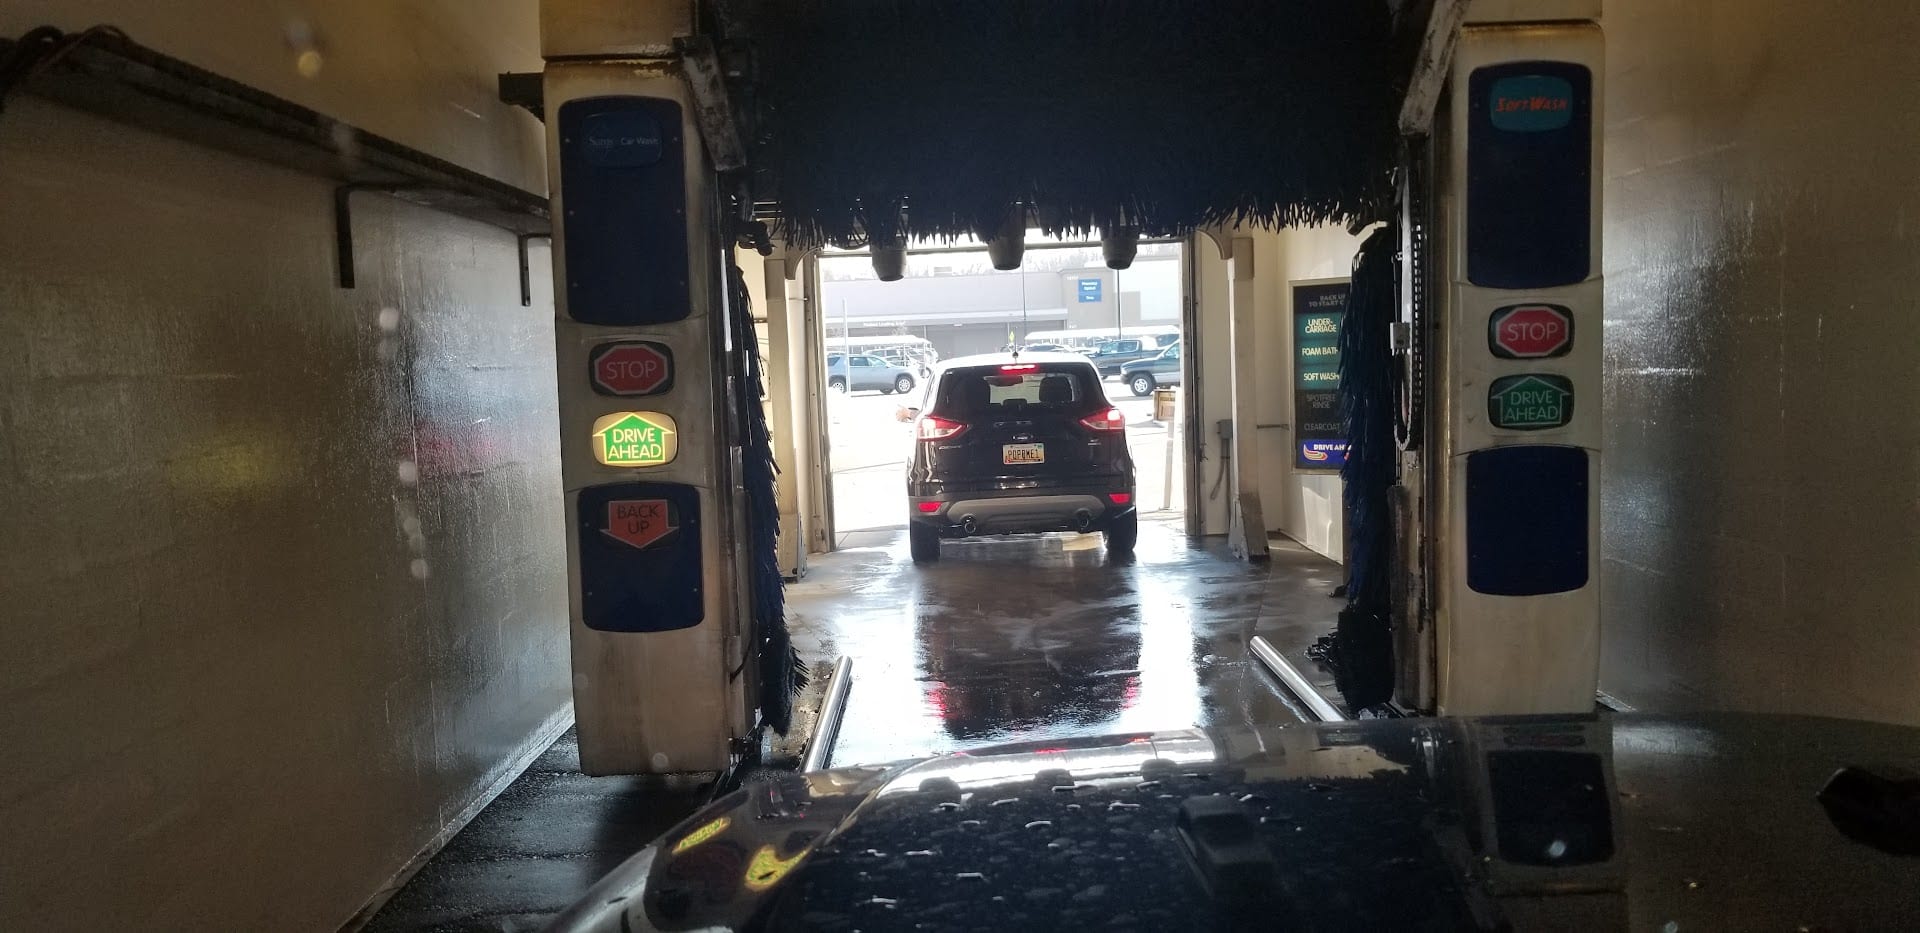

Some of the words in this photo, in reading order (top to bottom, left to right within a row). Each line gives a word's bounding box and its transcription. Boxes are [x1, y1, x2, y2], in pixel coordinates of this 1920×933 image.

[1305, 324, 1337, 334] CARRIAGE
[1507, 322, 1558, 342] STOP
[1302, 347, 1321, 356] FOAM
[606, 360, 657, 380] STOP
[1303, 372, 1319, 381] SOFT
[1312, 401, 1330, 409] RINSE
[1511, 390, 1553, 405] DRIVE
[1504, 405, 1558, 421] AHEAD
[612, 427, 656, 443] DRIVE
[608, 443, 662, 460] AHEAD
[617, 504, 660, 519] BACK
[627, 519, 651, 535] UP
